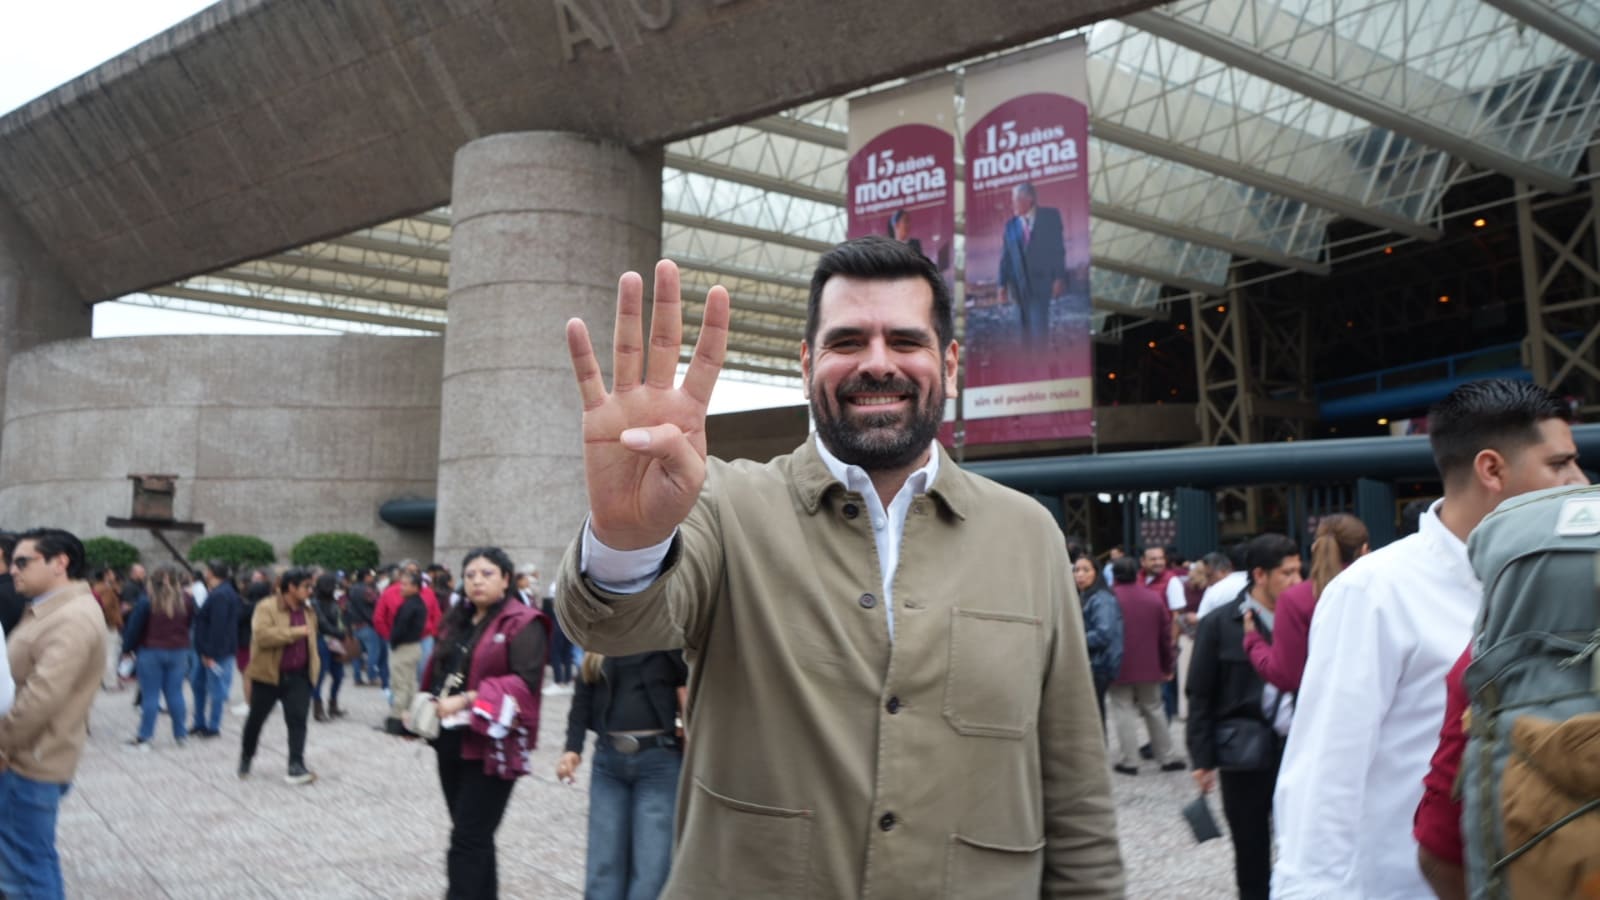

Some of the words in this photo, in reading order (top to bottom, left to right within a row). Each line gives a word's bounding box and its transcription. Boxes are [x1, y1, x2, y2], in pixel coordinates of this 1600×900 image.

[986, 121, 1018, 154] 15
[1019, 125, 1065, 147] años
[867, 149, 895, 181] 15
[895, 155, 936, 174] años
[973, 138, 1078, 180] morena
[855, 167, 947, 206] morena
